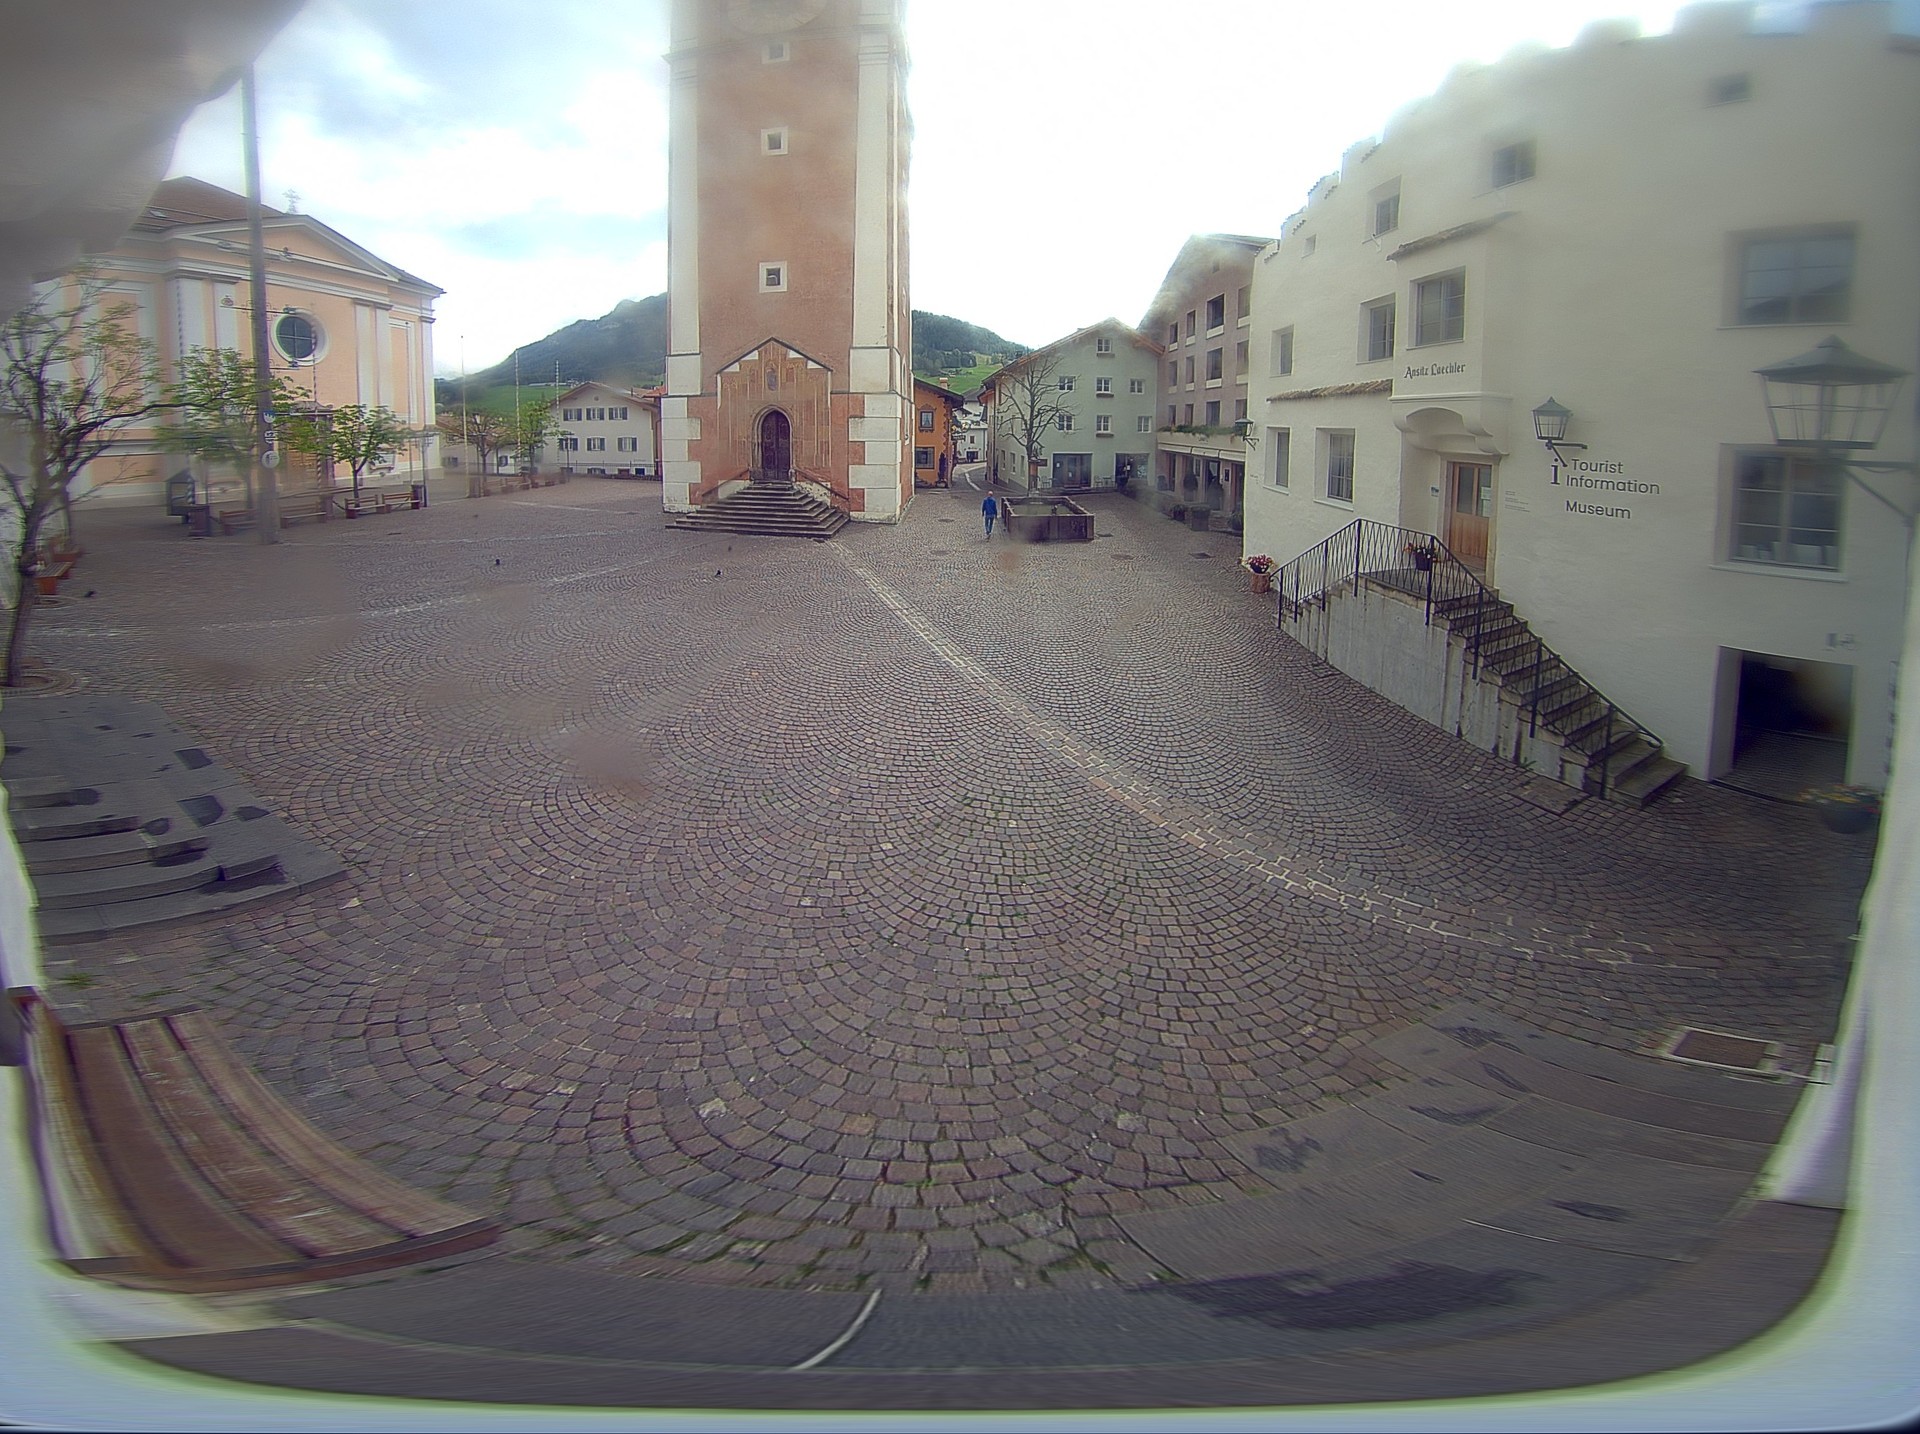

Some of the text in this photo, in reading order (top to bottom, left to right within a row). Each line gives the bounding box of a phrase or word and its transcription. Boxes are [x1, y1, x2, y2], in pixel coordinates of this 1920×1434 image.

[1571, 458, 1624, 474] Tourist
[1566, 474, 1660, 495] Information
[1565, 500, 1631, 519] Museum
